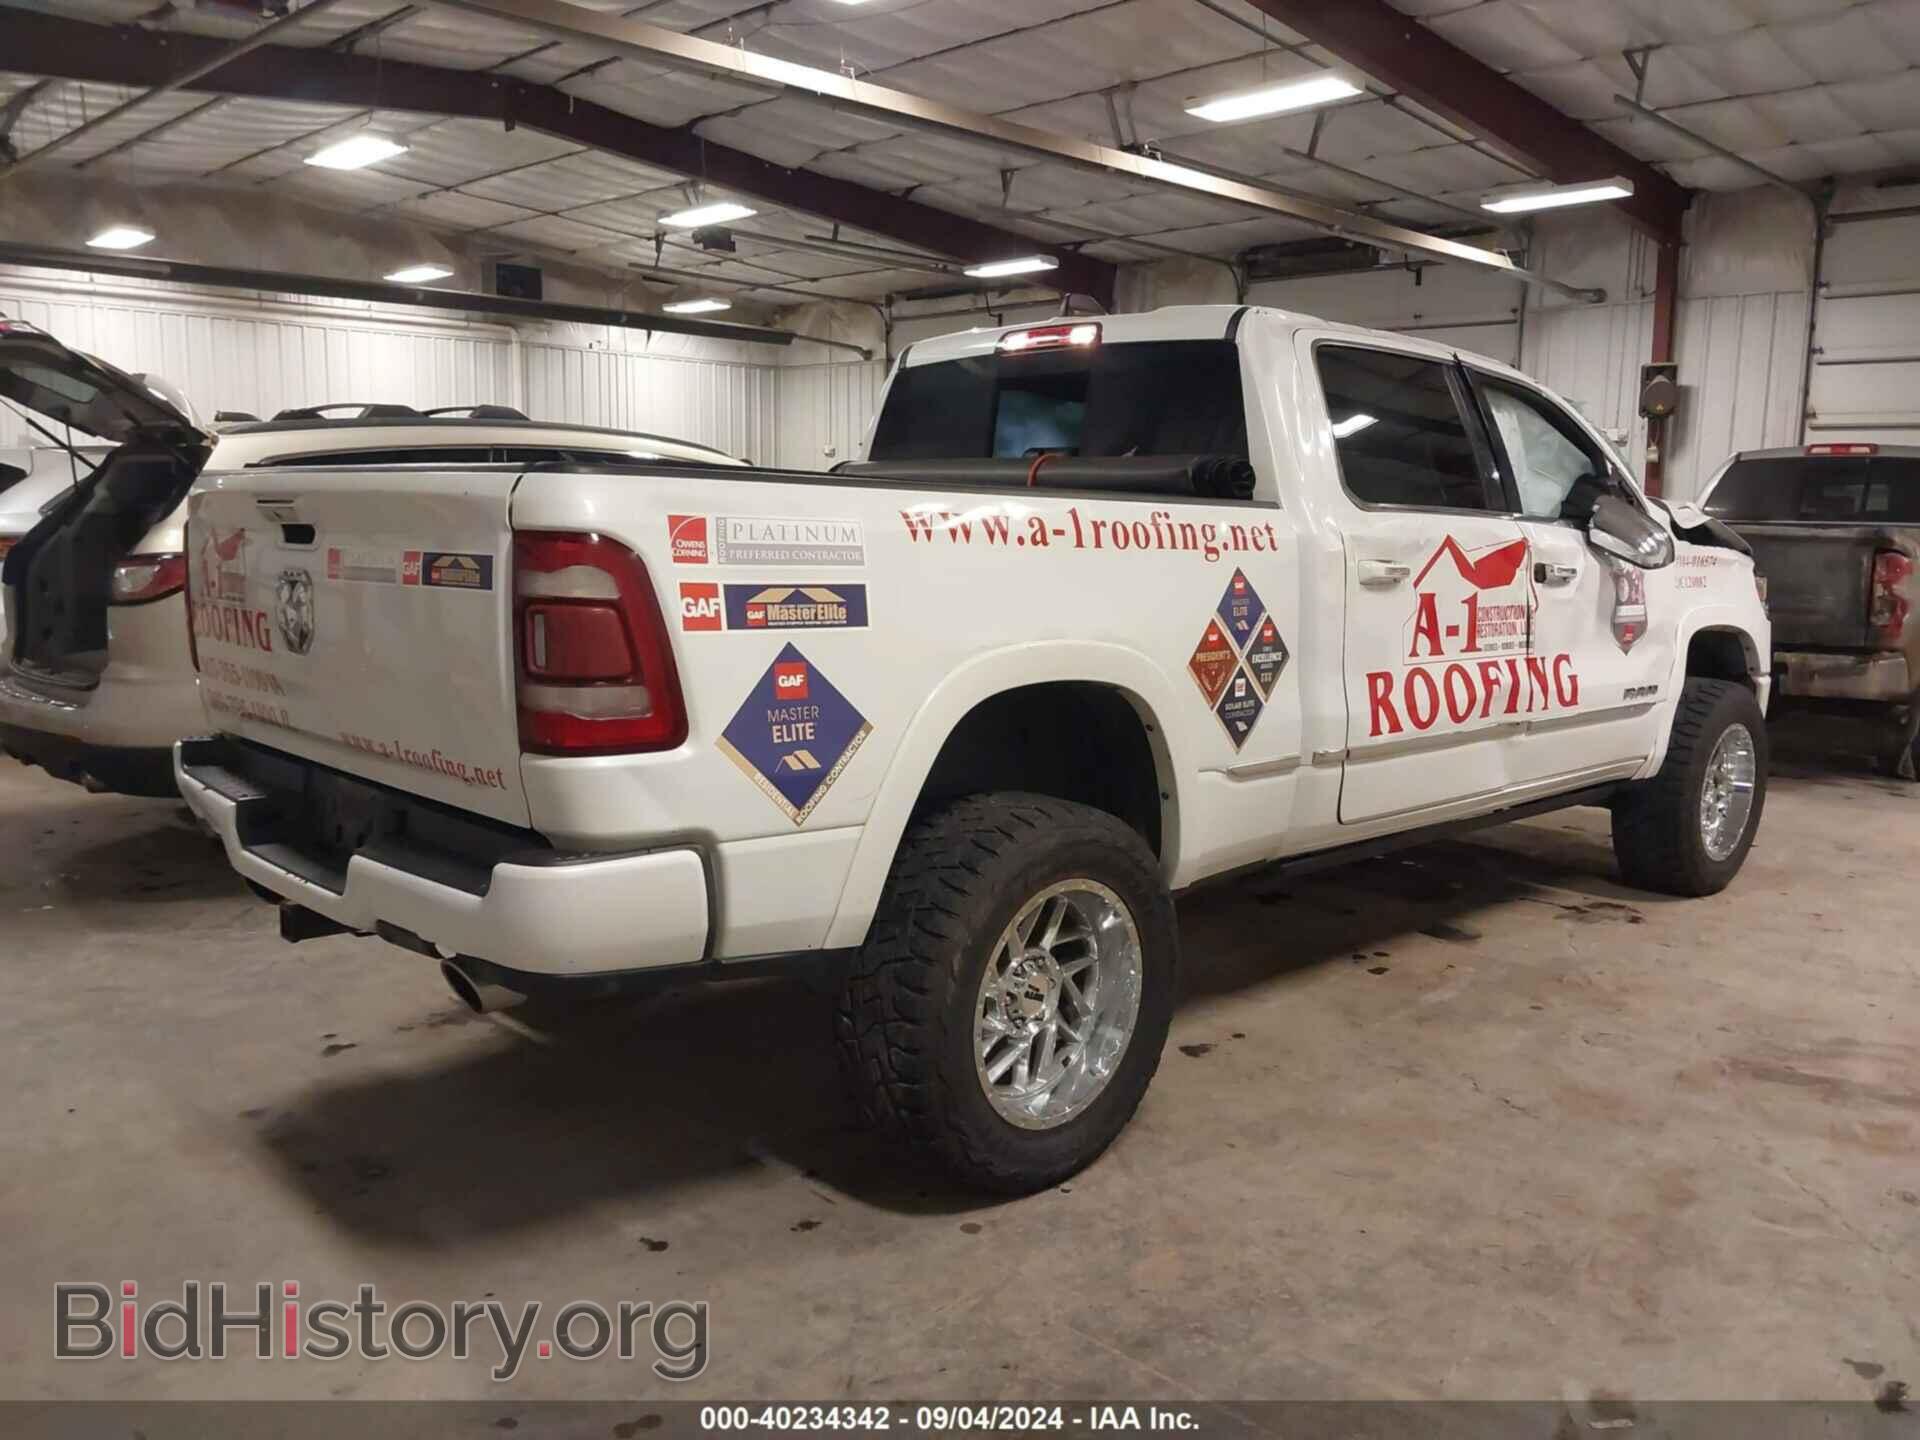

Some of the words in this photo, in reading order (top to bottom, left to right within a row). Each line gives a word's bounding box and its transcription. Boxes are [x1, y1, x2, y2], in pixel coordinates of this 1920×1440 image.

[732, 522, 858, 543] PLATINUM
[729, 549, 790, 561] PREFERRED
[791, 549, 862, 562] CONTRACTOR
[682, 597, 719, 619] GAF
[746, 609, 766, 619] GAF
[1408, 591, 1482, 658] A-1
[778, 674, 804, 688] GAF
[1366, 654, 1579, 737] ROOFING
[1622, 684, 1659, 700] RAM
[767, 705, 820, 723] MASTER
[772, 722, 815, 744] ELITE
